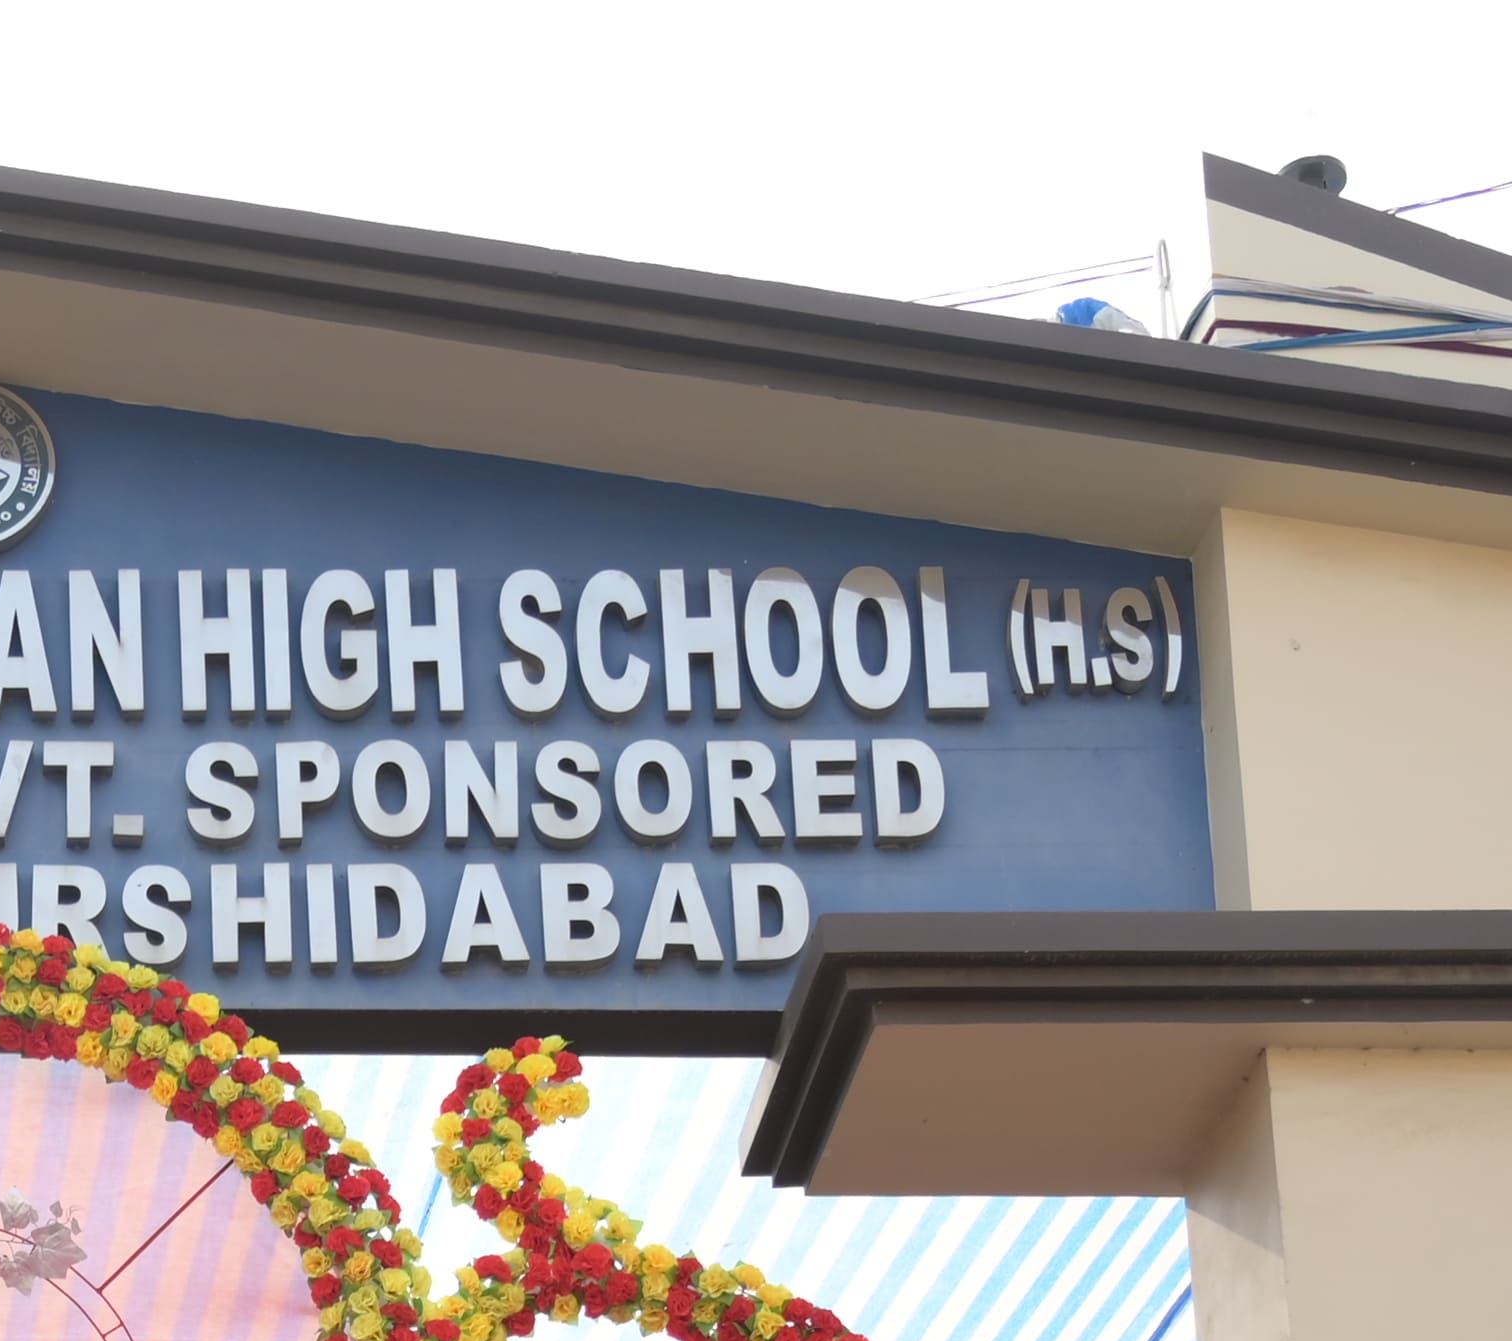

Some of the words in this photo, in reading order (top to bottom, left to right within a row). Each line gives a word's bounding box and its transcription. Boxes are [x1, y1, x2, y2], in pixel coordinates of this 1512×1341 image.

[178, 568, 463, 720] HIGH
[498, 566, 989, 720] SCHOOL
[1007, 576, 1183, 701] (H.S)
[186, 738, 946, 848] SPONSORED
